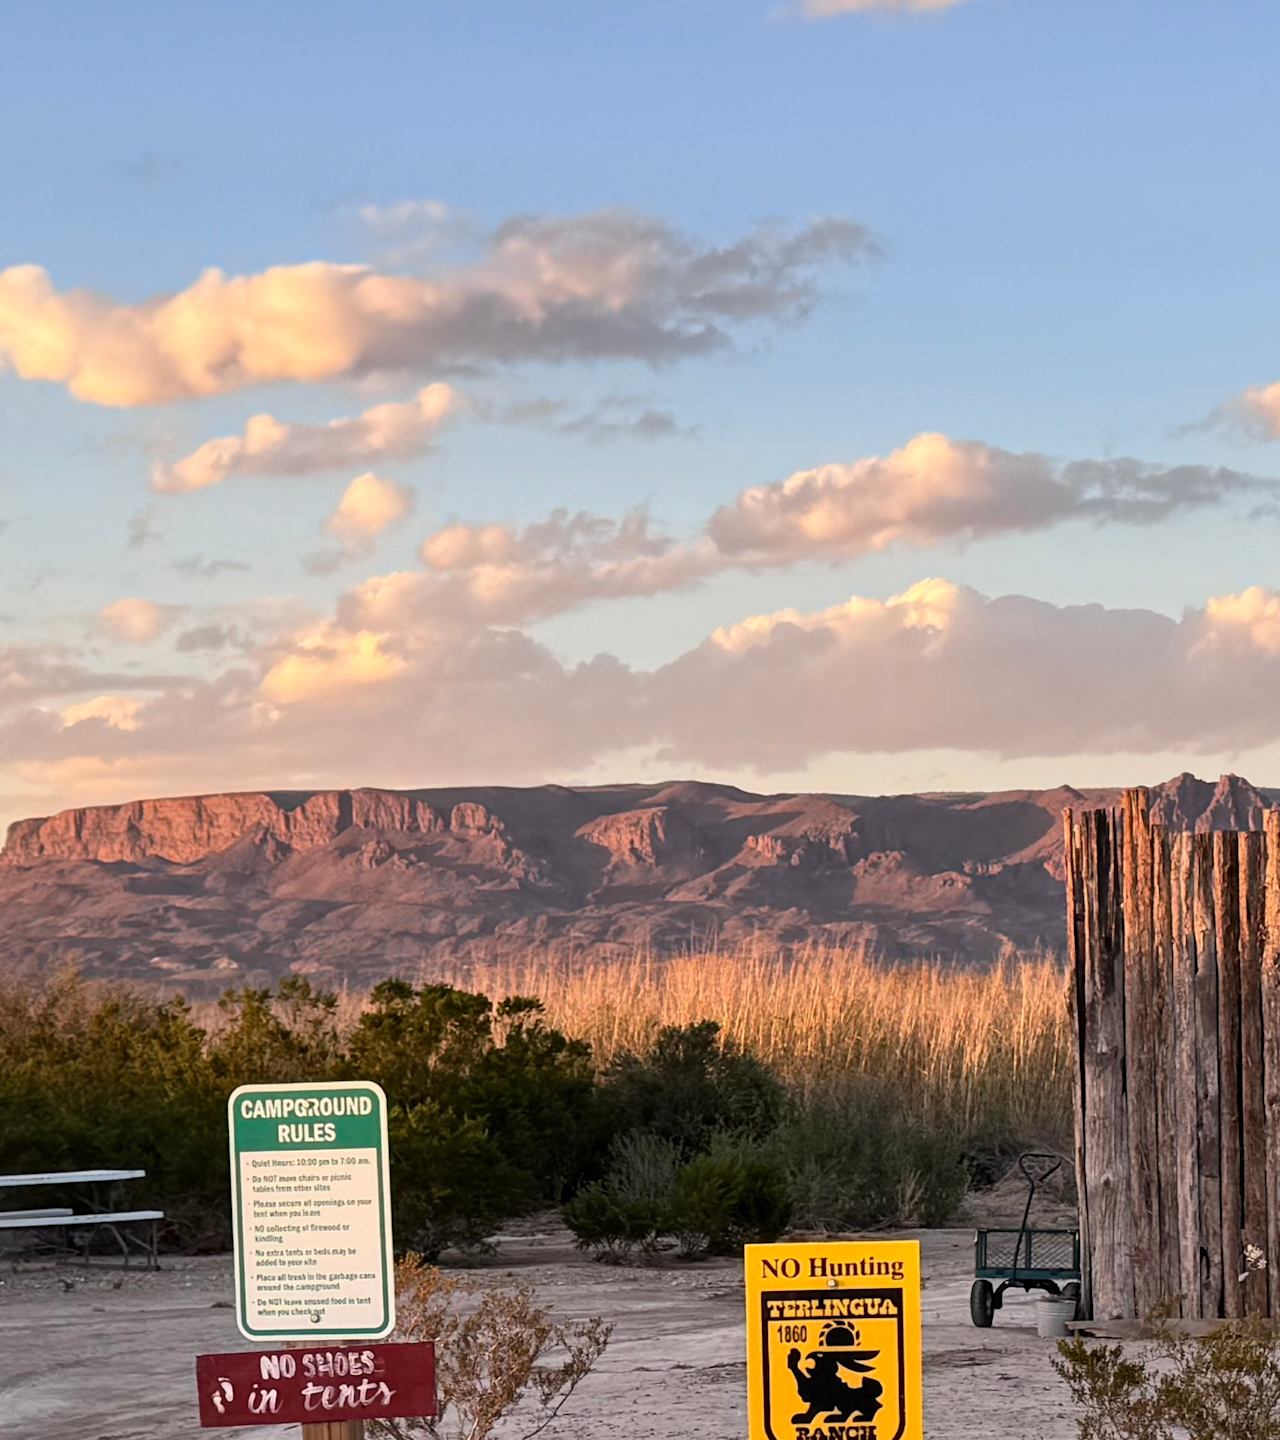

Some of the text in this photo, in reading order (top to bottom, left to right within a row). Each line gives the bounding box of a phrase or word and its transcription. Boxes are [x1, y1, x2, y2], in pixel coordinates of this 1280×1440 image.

[241, 1096, 372, 1119] CAMPGROUND
[278, 1122, 337, 1143] RULES
[761, 1256, 904, 1279] NO Hunting
[767, 1298, 898, 1317] TERLINGUA
[777, 1325, 807, 1343] 1860
[260, 1350, 375, 1379] NO SHOES
[248, 1381, 396, 1415] in tents
